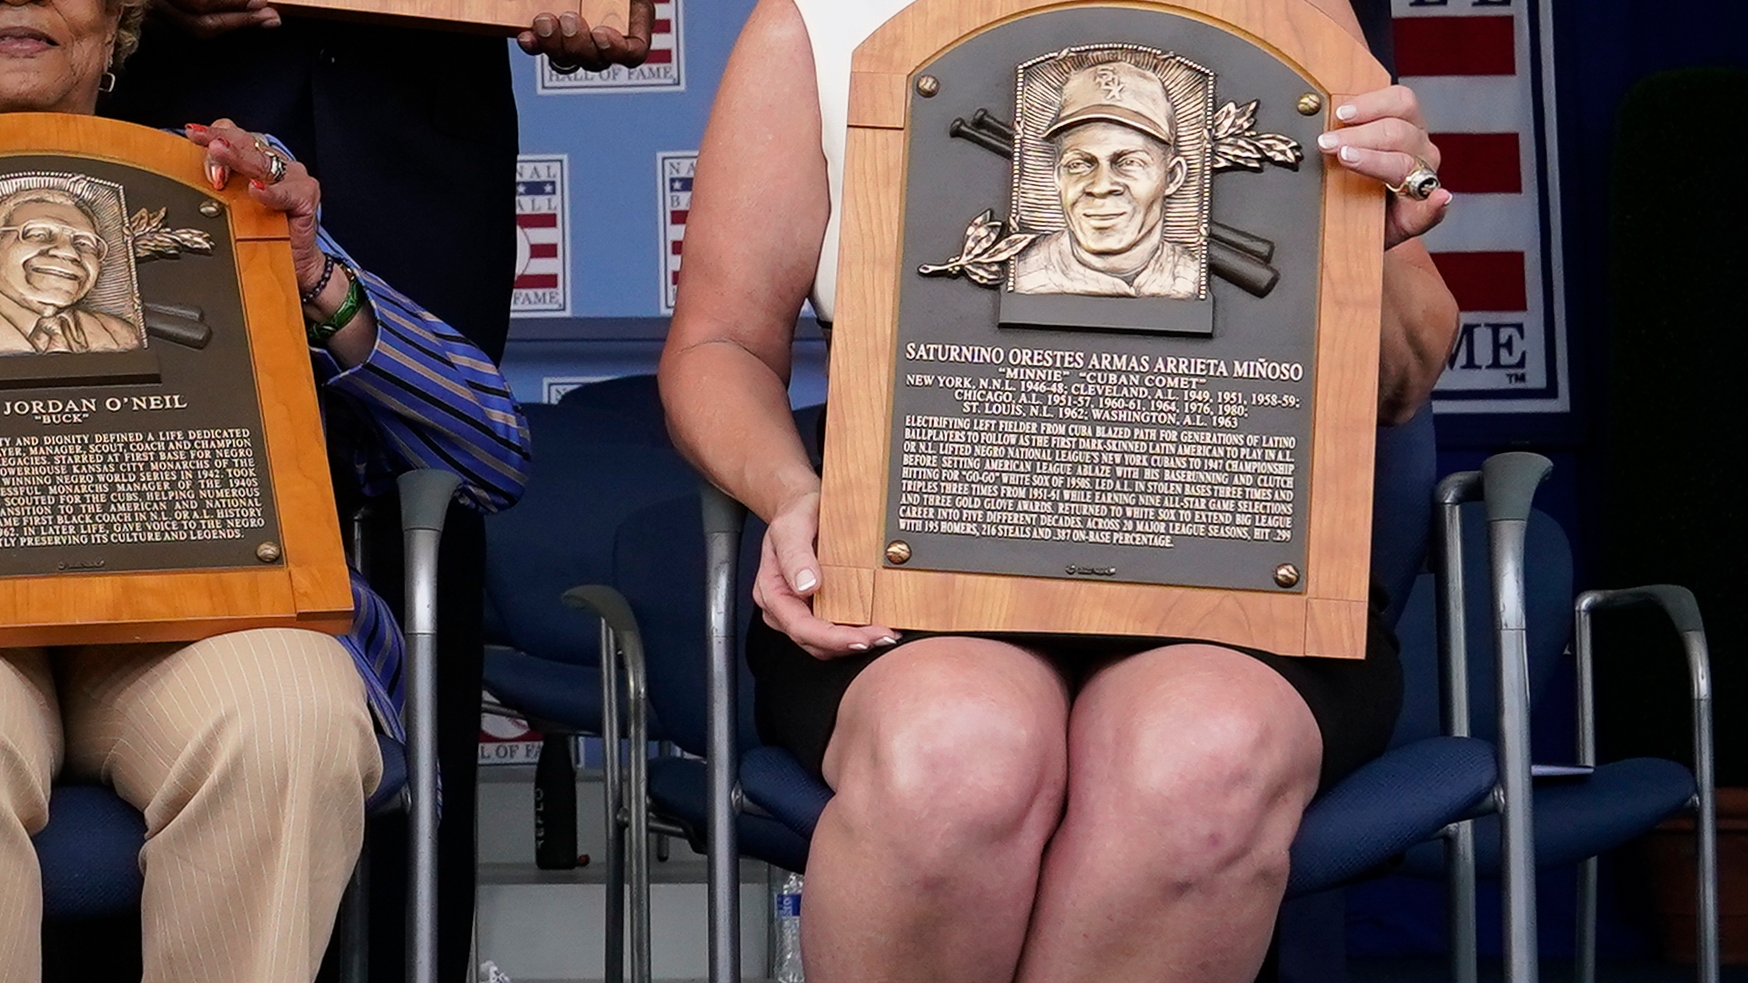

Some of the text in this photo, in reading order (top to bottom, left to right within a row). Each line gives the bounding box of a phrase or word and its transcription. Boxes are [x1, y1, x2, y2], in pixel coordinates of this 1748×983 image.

[598, 65, 622, 81] OF
[627, 65, 673, 81] FAME
[513, 291, 560, 306] FAME
[1448, 322, 1527, 370] ME
[906, 343, 1303, 381] SATURNINO ORESTES ARMAS ARRIETA MIÑOSO
[999, 367, 1205, 389] "MINNIE" "CUBAN COMET"
[906, 374, 934, 388] NEW
[938, 376, 975, 390] YORK,
[979, 378, 1016, 392] N.N.L.
[1071, 383, 1151, 399] CLEVELAND,
[1154, 387, 1178, 401] A.L.
[1184, 389, 1213, 403] 1949,
[1251, 392, 1300, 407] 1958-59;
[3, 398, 96, 416] JORDAN
[105, 394, 187, 413] O'NEIL
[954, 389, 1015, 404] CHICAGO,
[1018, 392, 1042, 406] A.L.
[1047, 394, 1094, 409] 1951-57,
[1099, 397, 1145, 411] 1960-61,
[1184, 401, 1213, 415] 1976,
[984, 402, 1026, 417] LOUIS,
[1091, 408, 1180, 425] WASHINGTON,
[1212, 414, 1238, 428] 1963
[15, 436, 38, 447] AND
[43, 434, 89, 446] DIGNITY
[94, 432, 143, 444] DEFINED
[147, 432, 154, 442] A
[159, 431, 184, 441] LIFE
[188, 428, 250, 440] DEDICATED
[496, 744, 520, 759] OF
